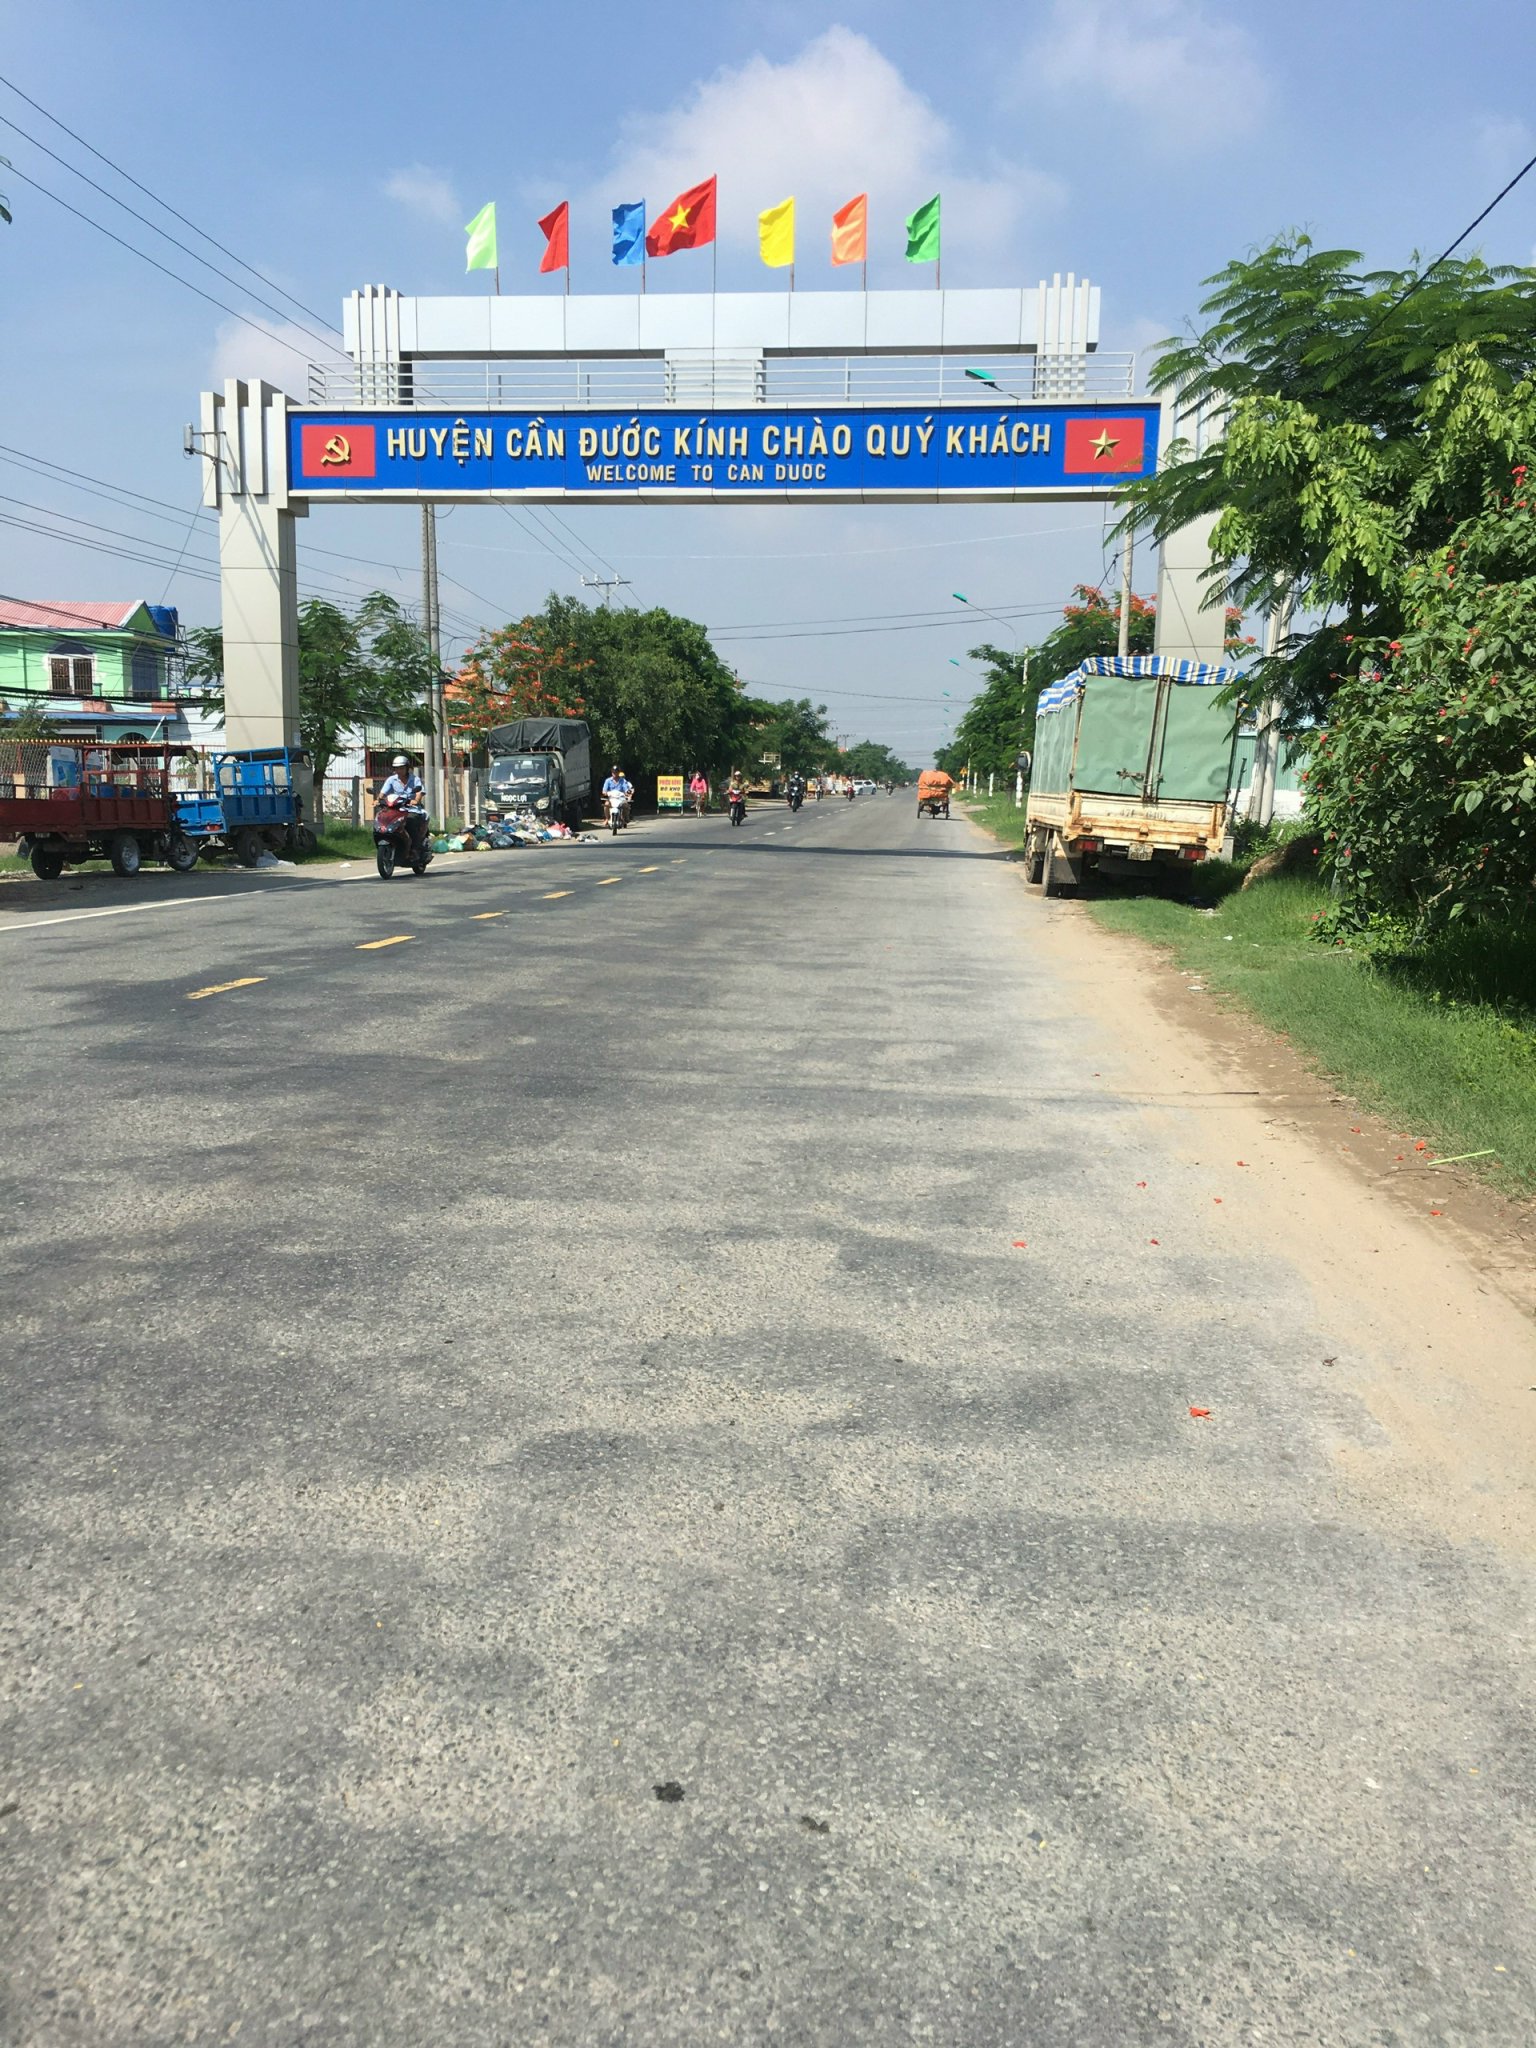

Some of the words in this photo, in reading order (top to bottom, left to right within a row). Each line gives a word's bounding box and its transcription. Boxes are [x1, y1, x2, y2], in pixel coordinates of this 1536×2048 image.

[387, 418, 492, 464] HUYỆN
[506, 417, 564, 457] CẦN
[578, 417, 660, 457] ĐƯỚC
[674, 418, 748, 456] KÍNH
[762, 417, 851, 456] CHÀO
[866, 416, 934, 456] QUÝ
[946, 415, 1050, 454] KHÁCH
[586, 464, 676, 481] WELCOME
[691, 464, 713, 481] TO
[727, 464, 763, 481] CAN
[775, 463, 826, 480] DUOC
